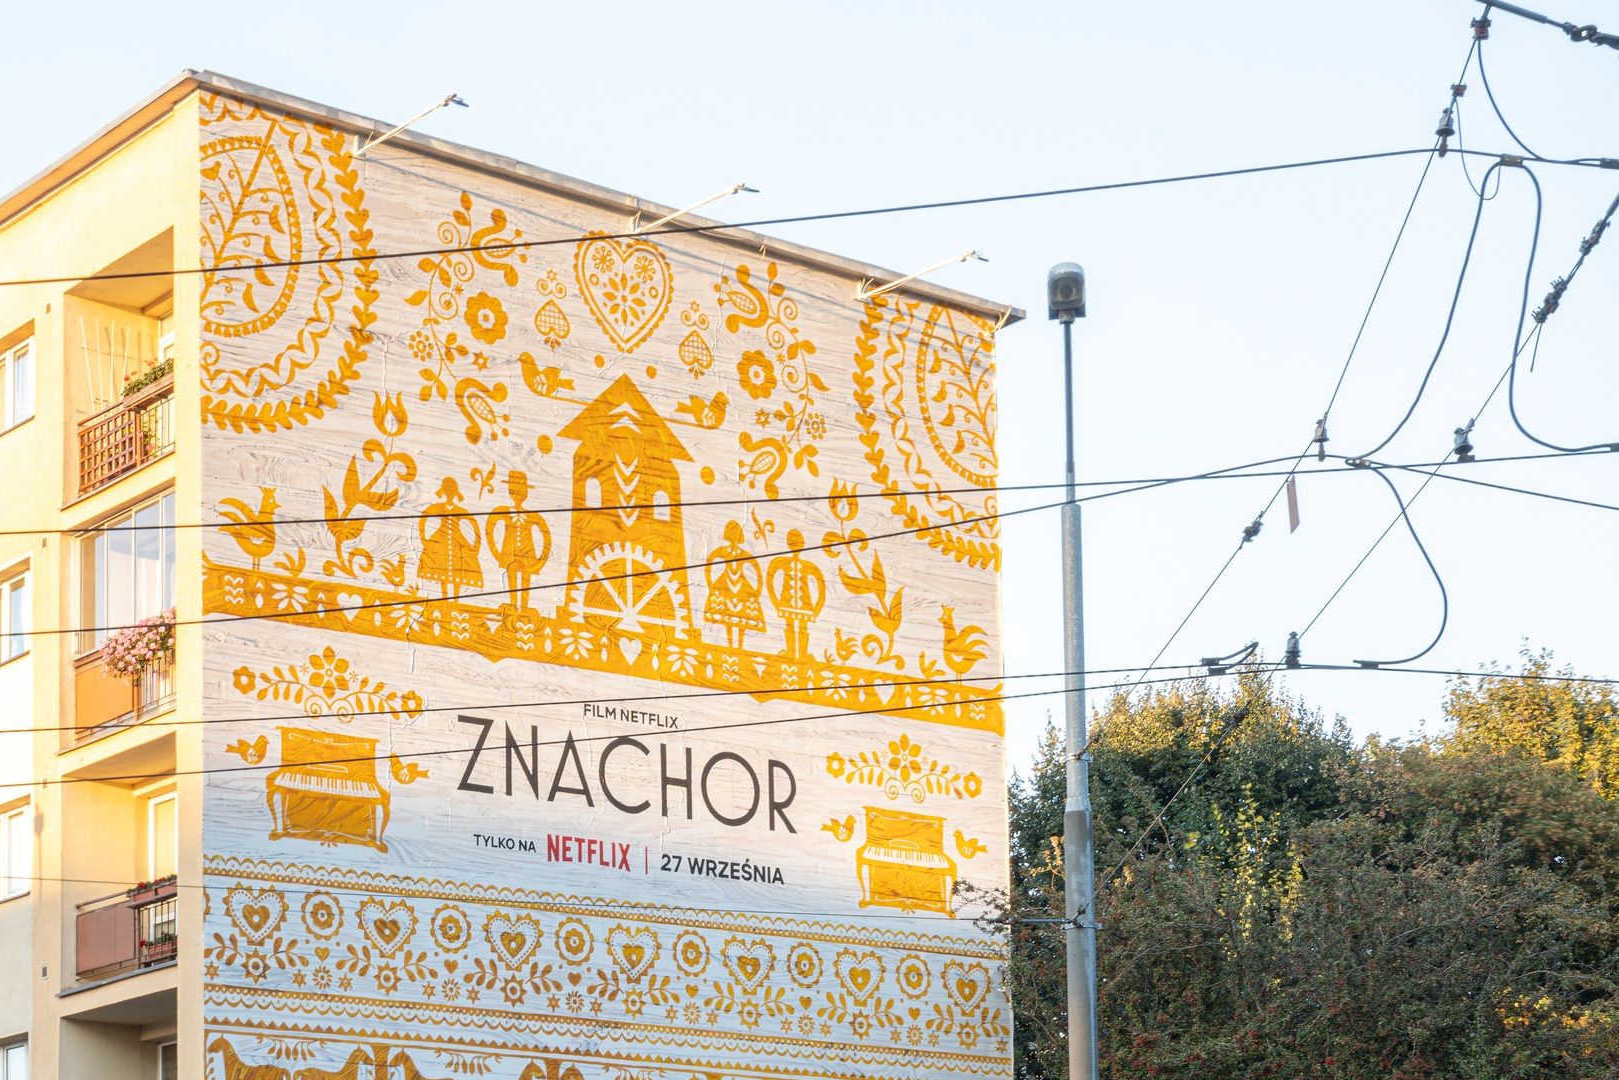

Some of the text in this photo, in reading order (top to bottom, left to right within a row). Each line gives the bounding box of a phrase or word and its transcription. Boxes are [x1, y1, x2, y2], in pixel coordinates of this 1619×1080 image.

[583, 703, 679, 730] FILM NETFLIX
[457, 714, 797, 834] ZNACHOR
[473, 833, 785, 885] TYLKO NA NETFLIX 27 WRZEŚNIA
